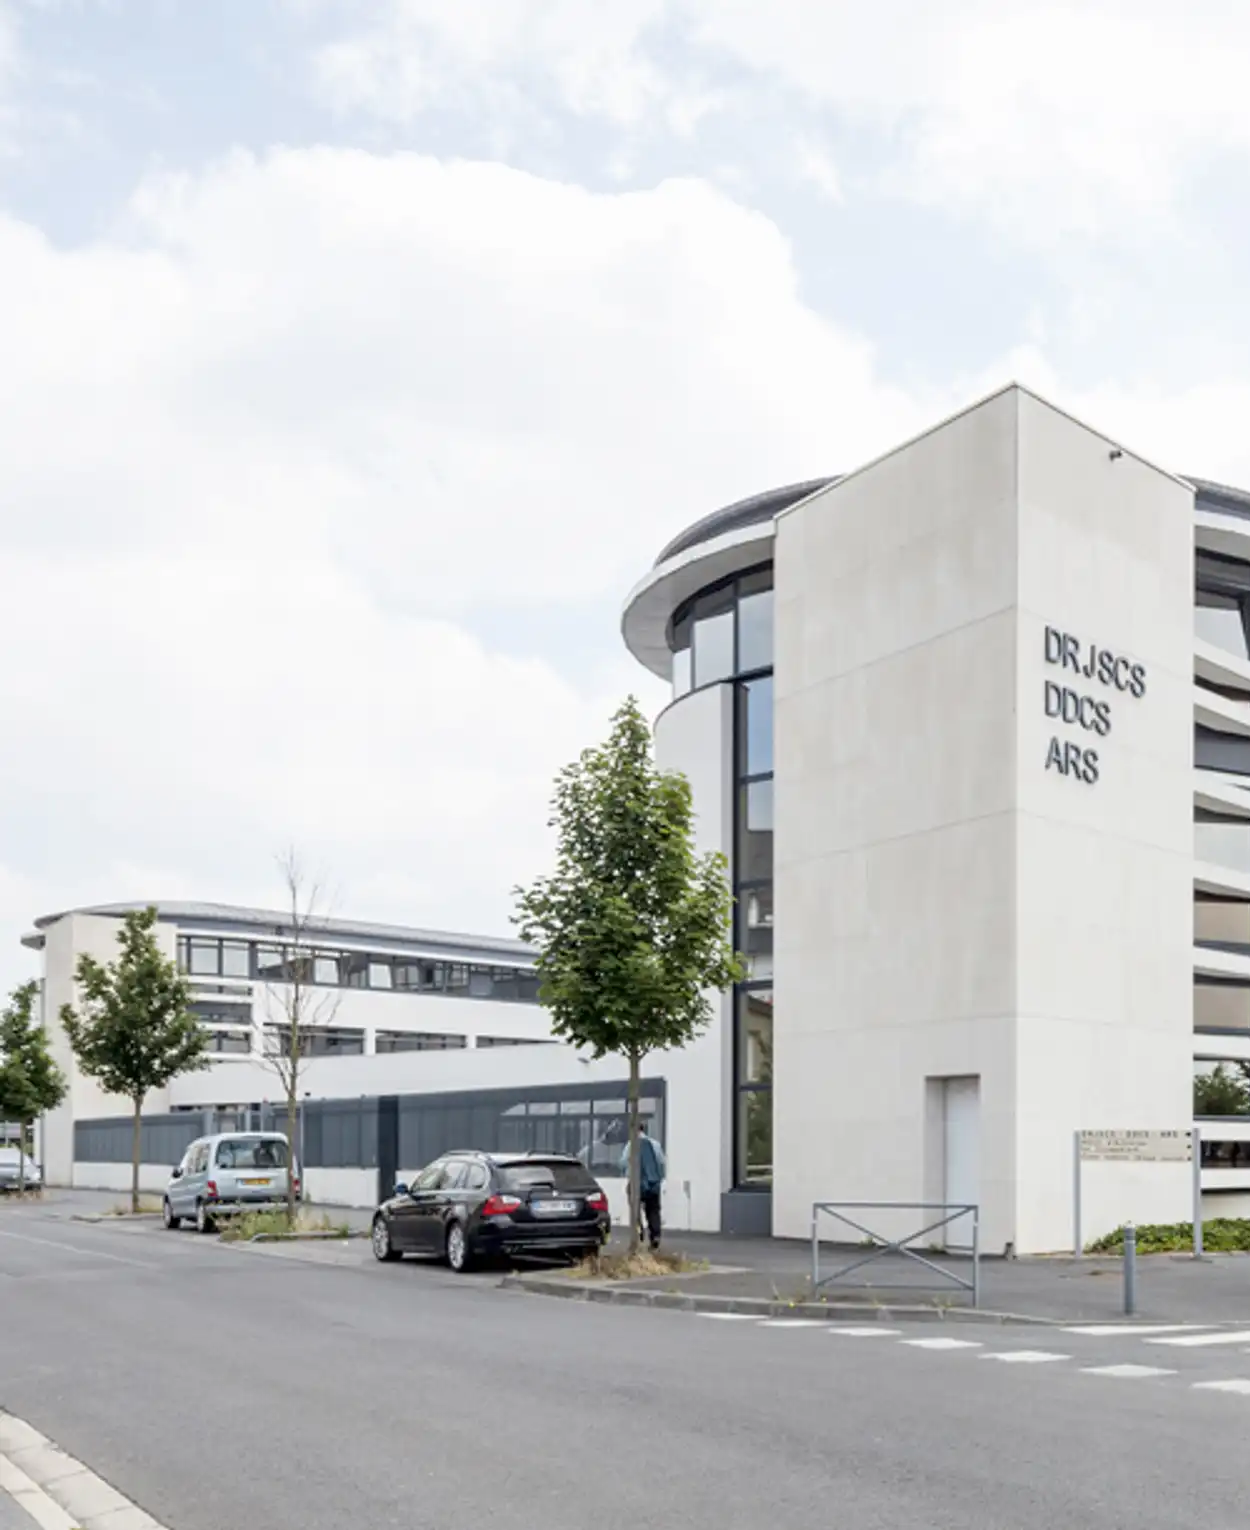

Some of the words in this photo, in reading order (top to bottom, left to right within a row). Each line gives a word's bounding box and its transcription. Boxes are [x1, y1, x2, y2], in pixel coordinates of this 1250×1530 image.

[1045, 625, 1146, 698] DRJSCS
[1045, 680, 1111, 736] DDCS
[1045, 736, 1099, 784] ARS
